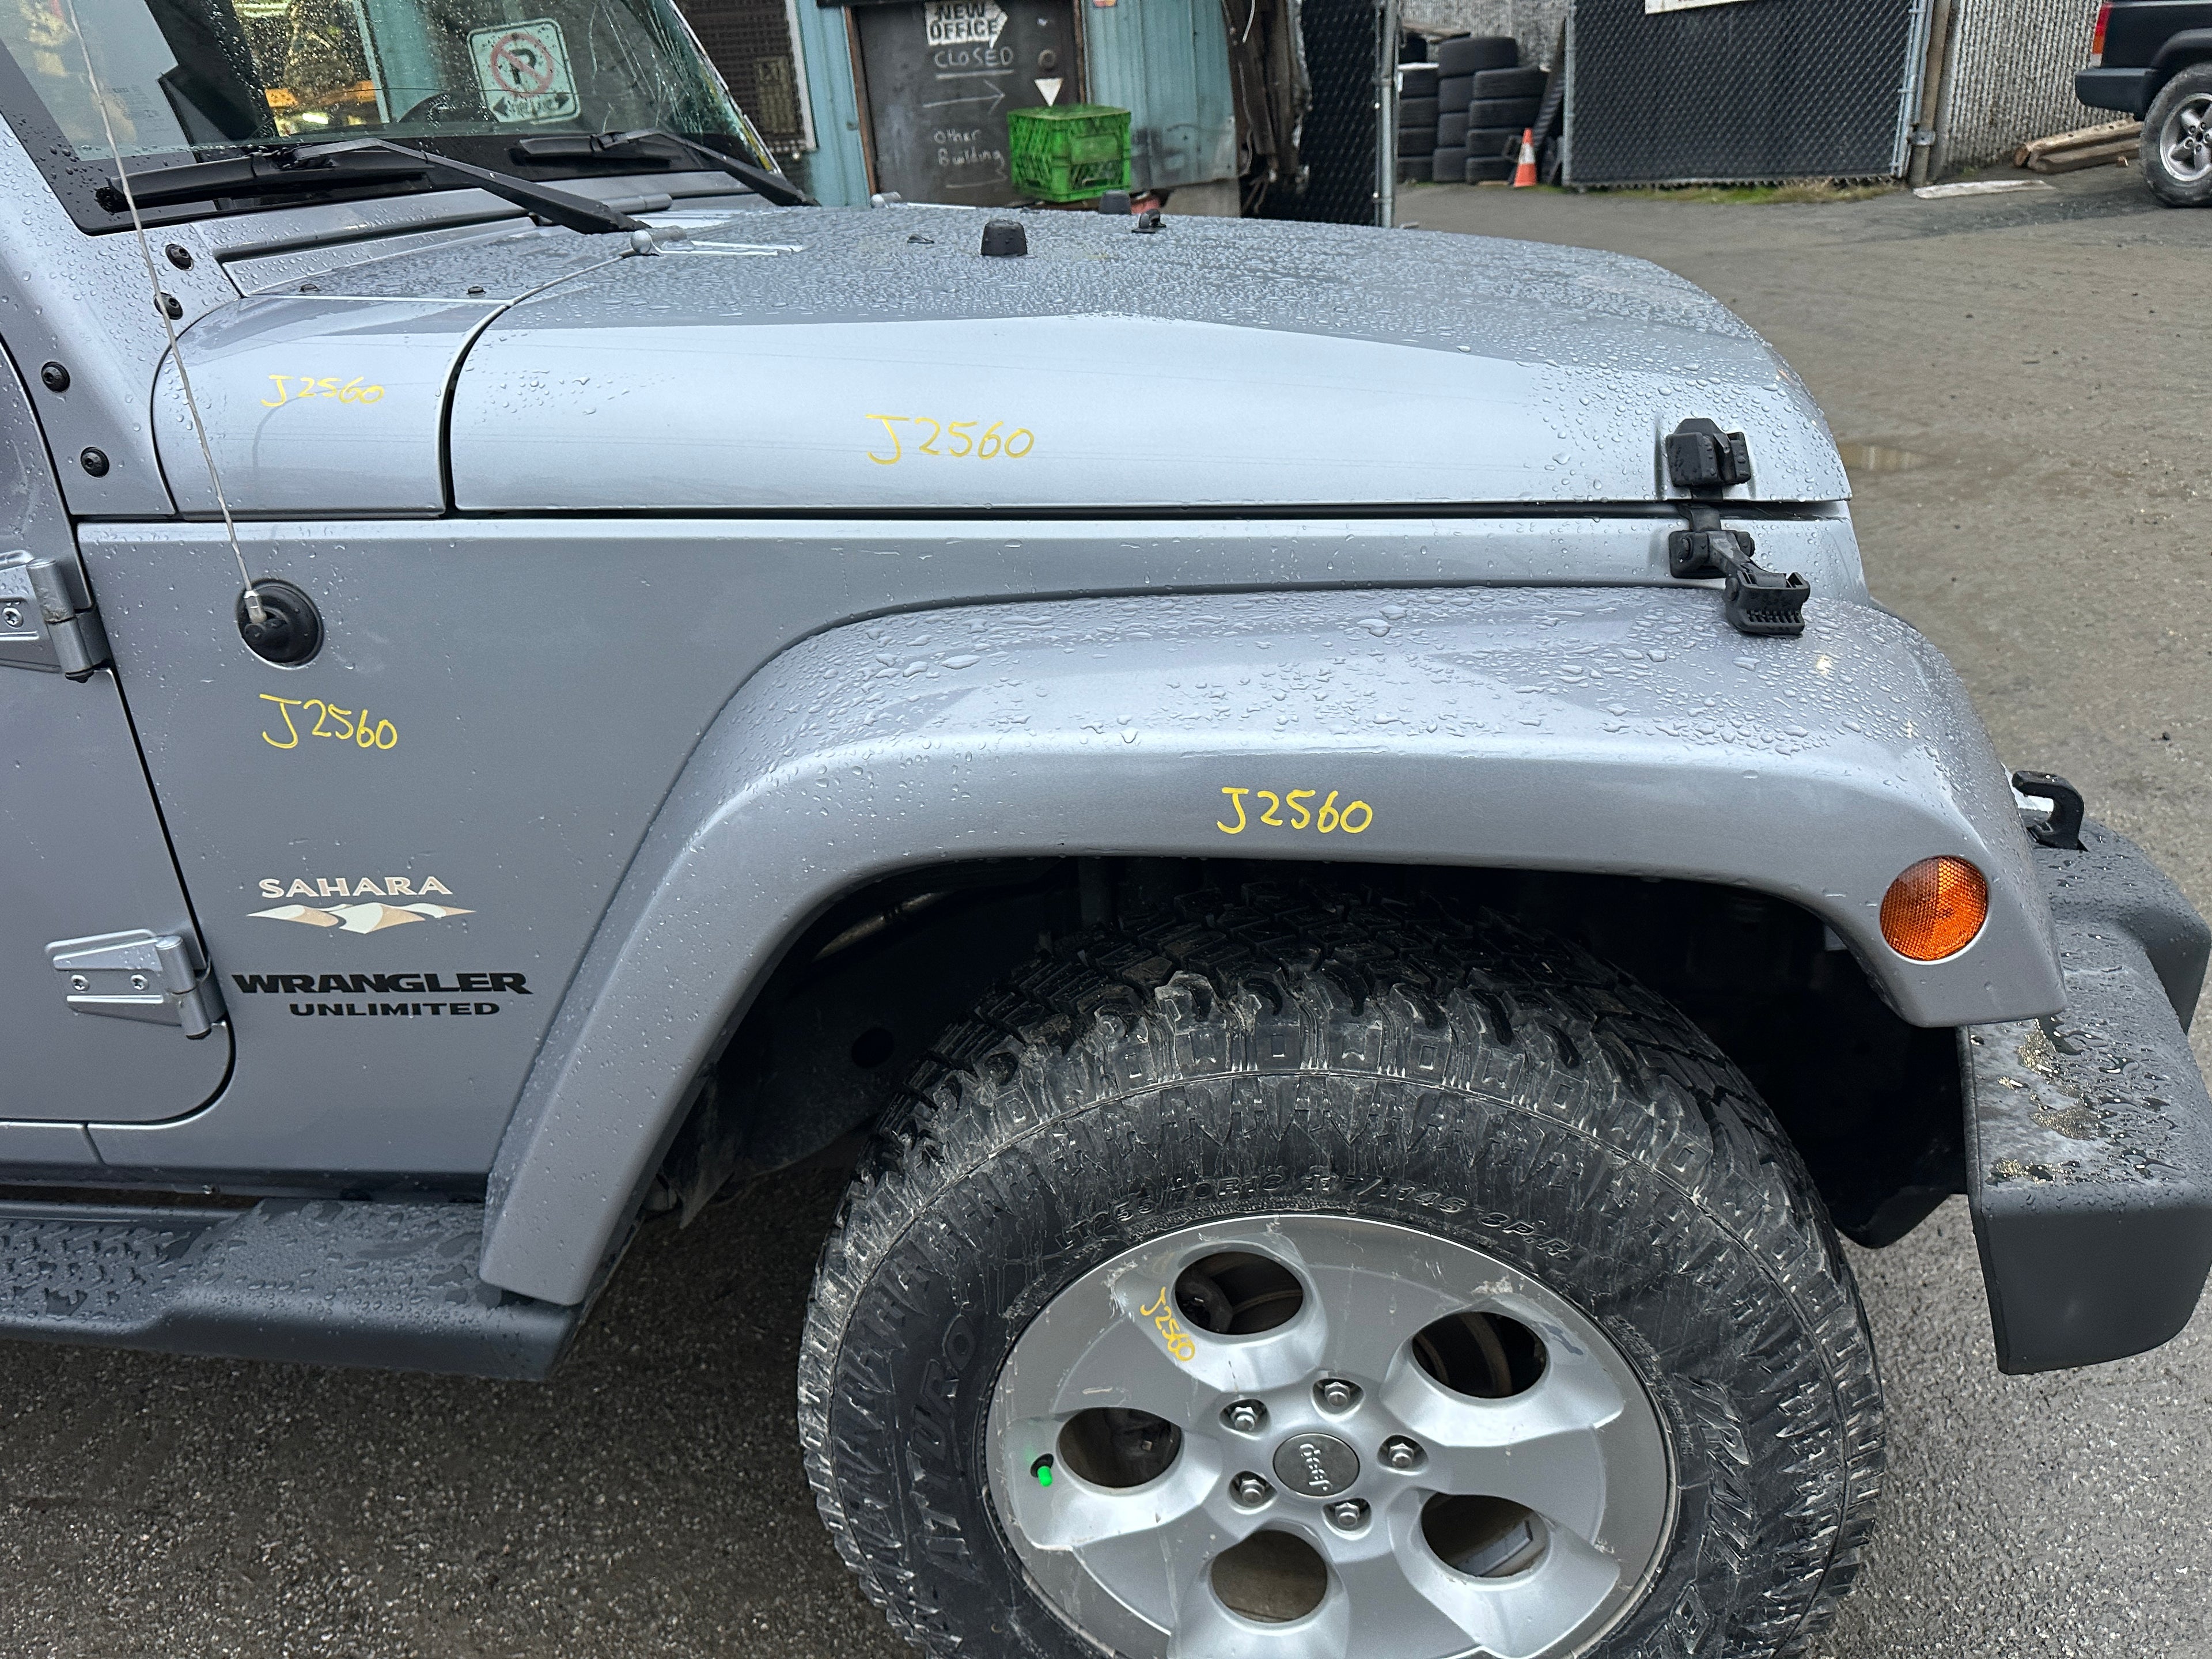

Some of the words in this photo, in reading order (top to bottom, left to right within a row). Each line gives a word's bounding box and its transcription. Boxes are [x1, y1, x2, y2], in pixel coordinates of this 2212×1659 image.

[935, 2, 985, 20] NEW
[929, 19, 998, 40] OFFICE
[934, 46, 1014, 68] CLOSED
[261, 374, 384, 407] J2560
[866, 414, 1035, 465] J2560
[259, 694, 397, 749] J2560
[1217, 787, 1373, 834] J2560
[259, 876, 453, 898] SAHARA
[232, 972, 533, 995] WRANGLER
[289, 1002, 500, 1016] UNLIMITED
[1140, 1286, 1195, 1361] J2560
[1299, 1443, 1333, 1491] Jeep
